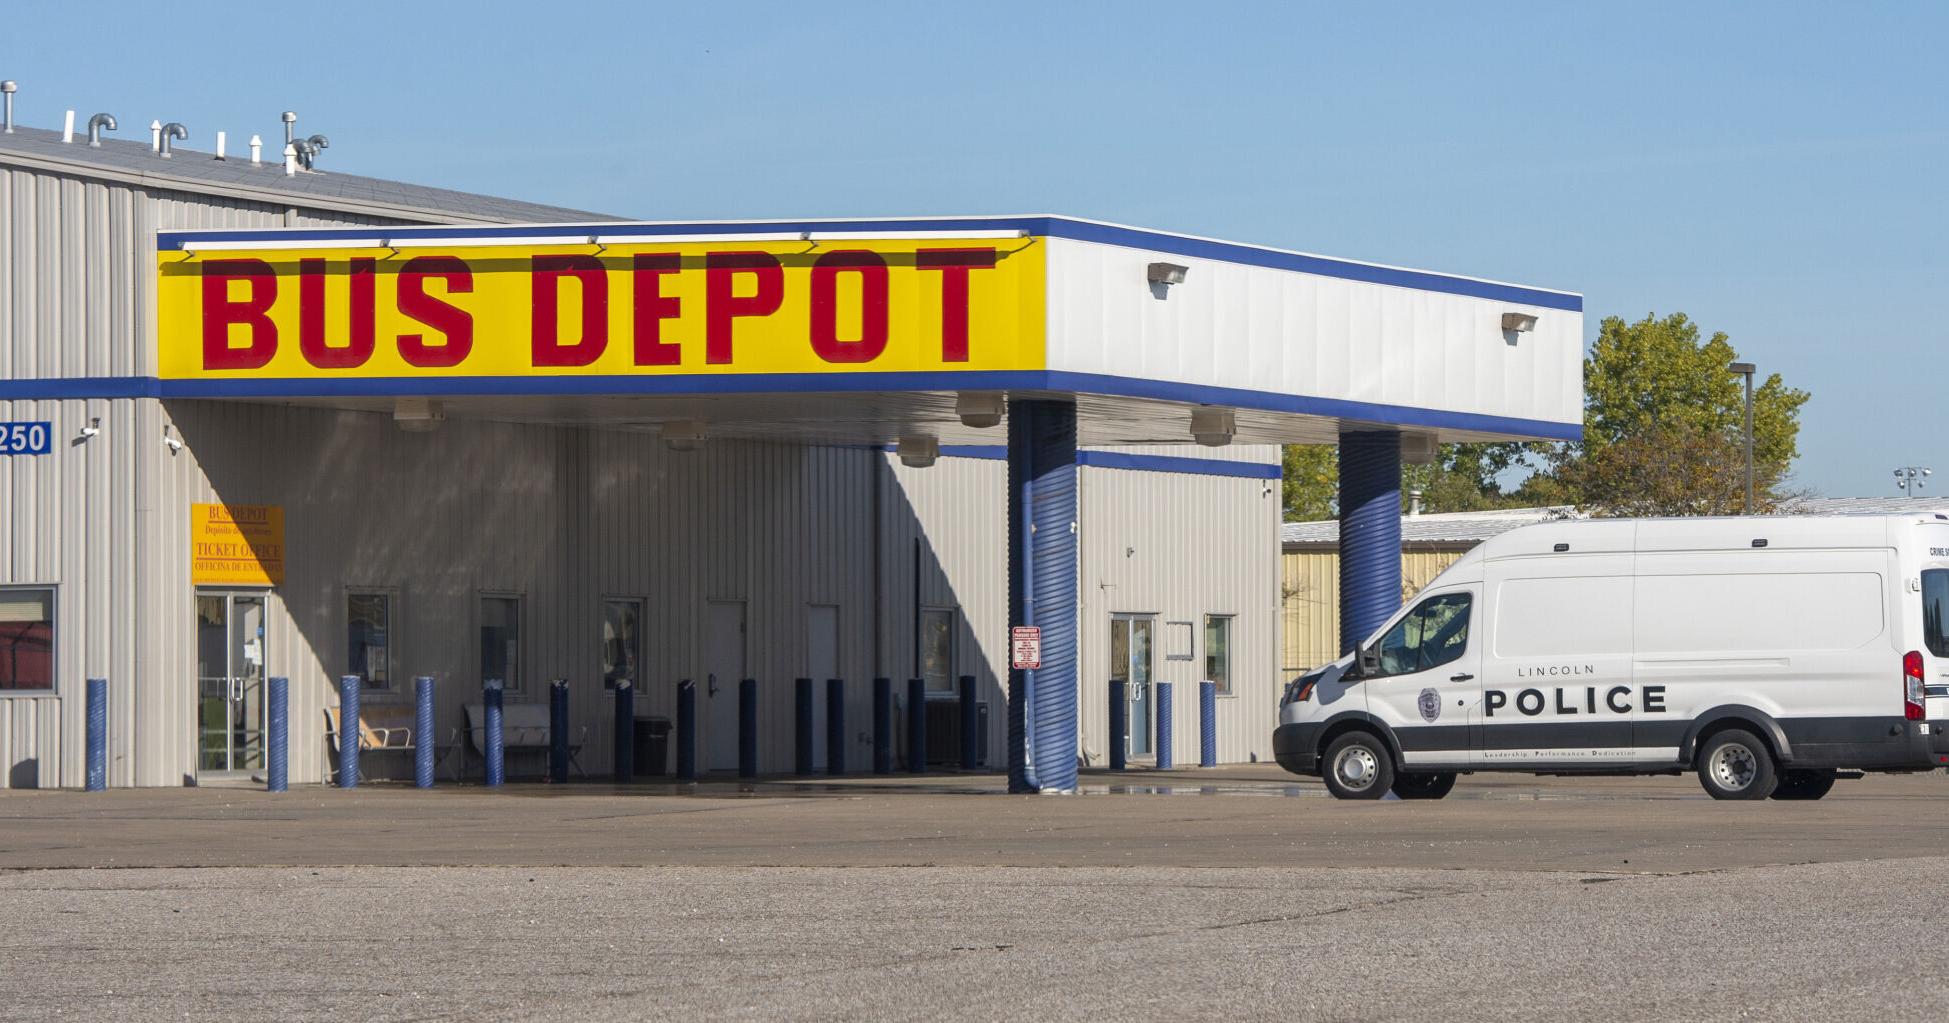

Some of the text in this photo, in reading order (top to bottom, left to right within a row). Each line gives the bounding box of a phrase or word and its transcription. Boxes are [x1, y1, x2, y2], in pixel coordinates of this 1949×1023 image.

[202, 247, 996, 370] BUS DEPOT
[209, 505, 268, 520] BUS DEPOT
[197, 542, 281, 557] TICKET OFFICE
[1930, 547, 1945, 556] CRIME
[231, 562, 240, 571] DE
[1518, 664, 1594, 677] LINCOLN
[1485, 685, 1666, 717] POLICE
[1484, 751, 1528, 759] Leadership
[1592, 749, 1636, 757] Dedication
